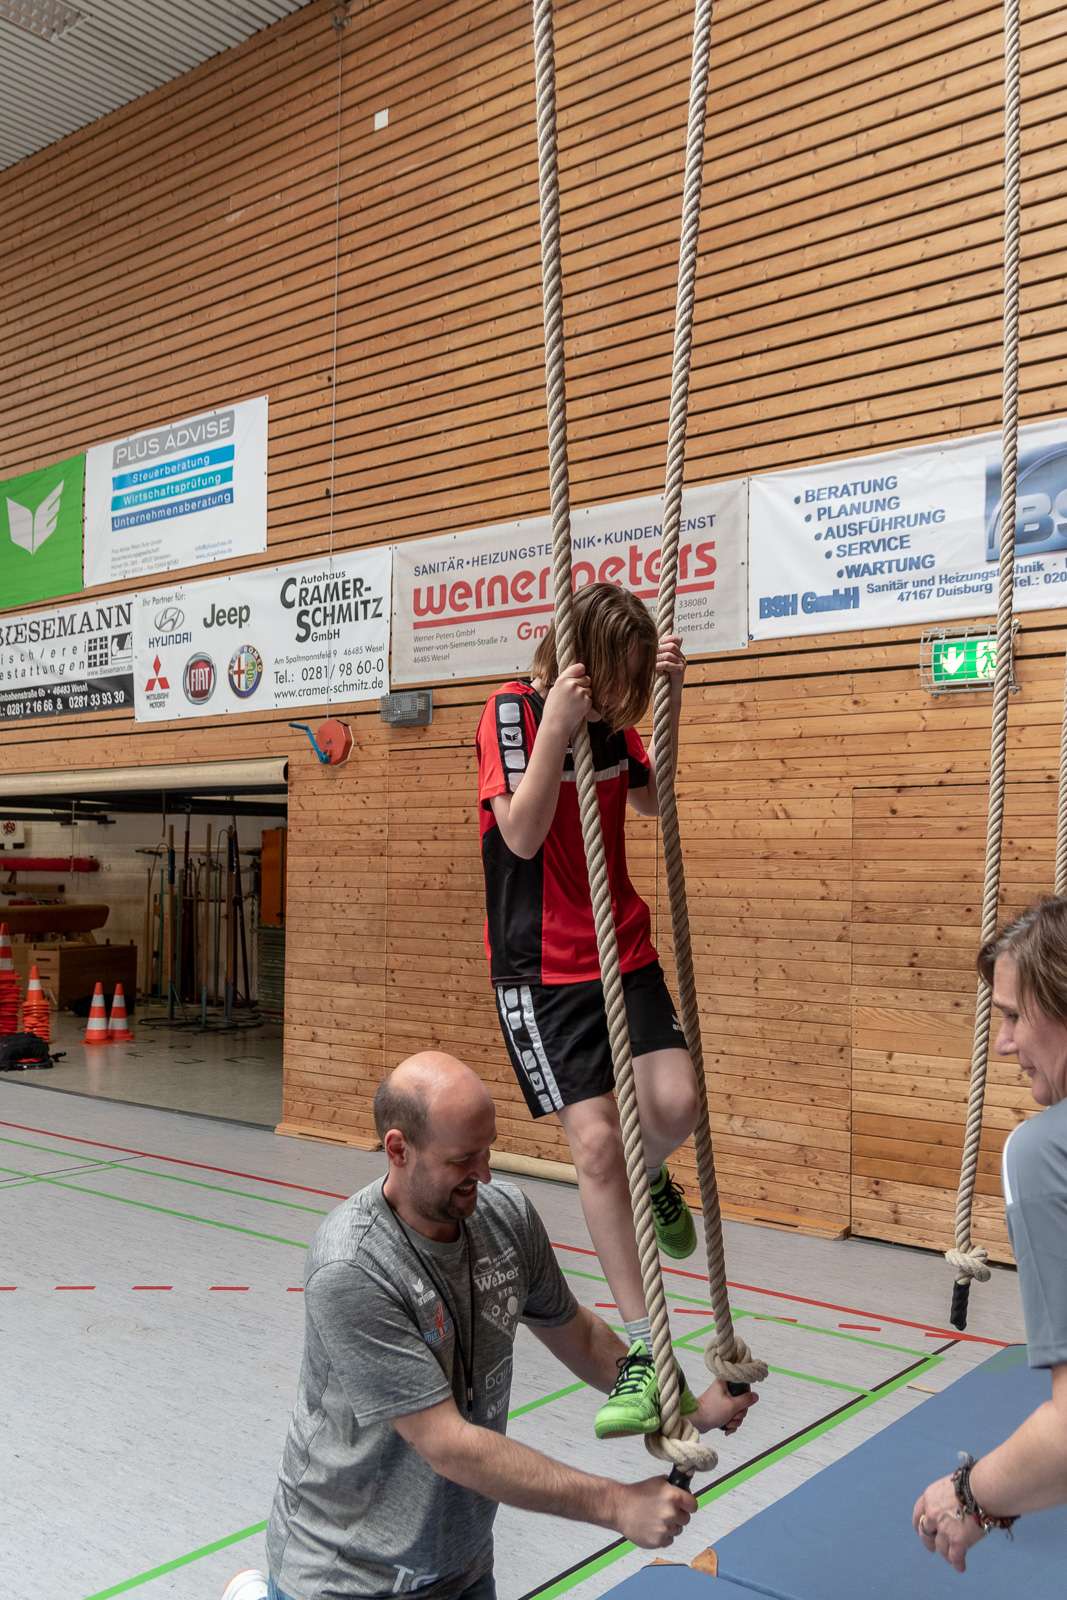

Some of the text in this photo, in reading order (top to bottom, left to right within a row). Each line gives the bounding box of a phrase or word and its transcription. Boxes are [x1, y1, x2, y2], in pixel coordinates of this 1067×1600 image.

[116, 418, 230, 464] PLUS ADVISE
[132, 455, 210, 484] Steuerberatung
[123, 473, 222, 506] Wirtschaftsprüfung
[804, 476, 898, 503] BERATUNG
[114, 492, 231, 528] Unternehmensberatung
[817, 496, 900, 522] PLANUNG
[824, 509, 946, 540] AUSFÜHRUNG
[414, 514, 716, 577] SANITÄR HEIZUNGSTENIK KUNDENENST
[836, 534, 911, 558] SERVICE
[300, 570, 346, 586] Autohaus
[845, 554, 936, 580] WARTUNG
[866, 561, 1045, 594] Sanitär und Heizungsthnik
[142, 598, 151, 607] Ihr
[152, 594, 173, 606] Partner
[280, 577, 372, 609] CRAMER-
[414, 566, 550, 617] werner
[897, 588, 933, 602] 47167
[936, 582, 993, 599] Duisburg
[1014, 575, 1039, 588] Tel.:
[203, 603, 251, 628] Jeep
[678, 597, 708, 608] 338080
[759, 586, 860, 619] BSH GmbH
[295, 596, 383, 643] SCHMITZ
[148, 632, 192, 648] HYUNDAI
[311, 628, 340, 642] GmbH
[414, 628, 476, 643] Werner Peters GmbH
[414, 636, 498, 653] Werner-von-Siemens-Straße
[274, 657, 284, 665] Am
[344, 647, 364, 656] 46485
[364, 643, 385, 653] Wesel
[413, 653, 450, 664] 46485 Wesel
[190, 667, 210, 692] FIAT
[274, 670, 294, 684] Tel.:
[339, 663, 353, 676] 98
[357, 658, 384, 675] 60-0
[71, 682, 88, 692] Wesel
[146, 692, 169, 701] MITSUBISHI
[274, 677, 384, 699] www.cramer-schmitz.de
[7, 704, 24, 716] 0281
[26, 702, 31, 713] 2
[33, 700, 42, 712] 16
[44, 699, 53, 711] 66
[69, 694, 88, 708] 0281
[90, 693, 100, 706] 33
[102, 692, 112, 705] 93
[114, 690, 125, 704] 30
[149, 700, 166, 709] MOTORS
[474, 1266, 519, 1292] Weber
